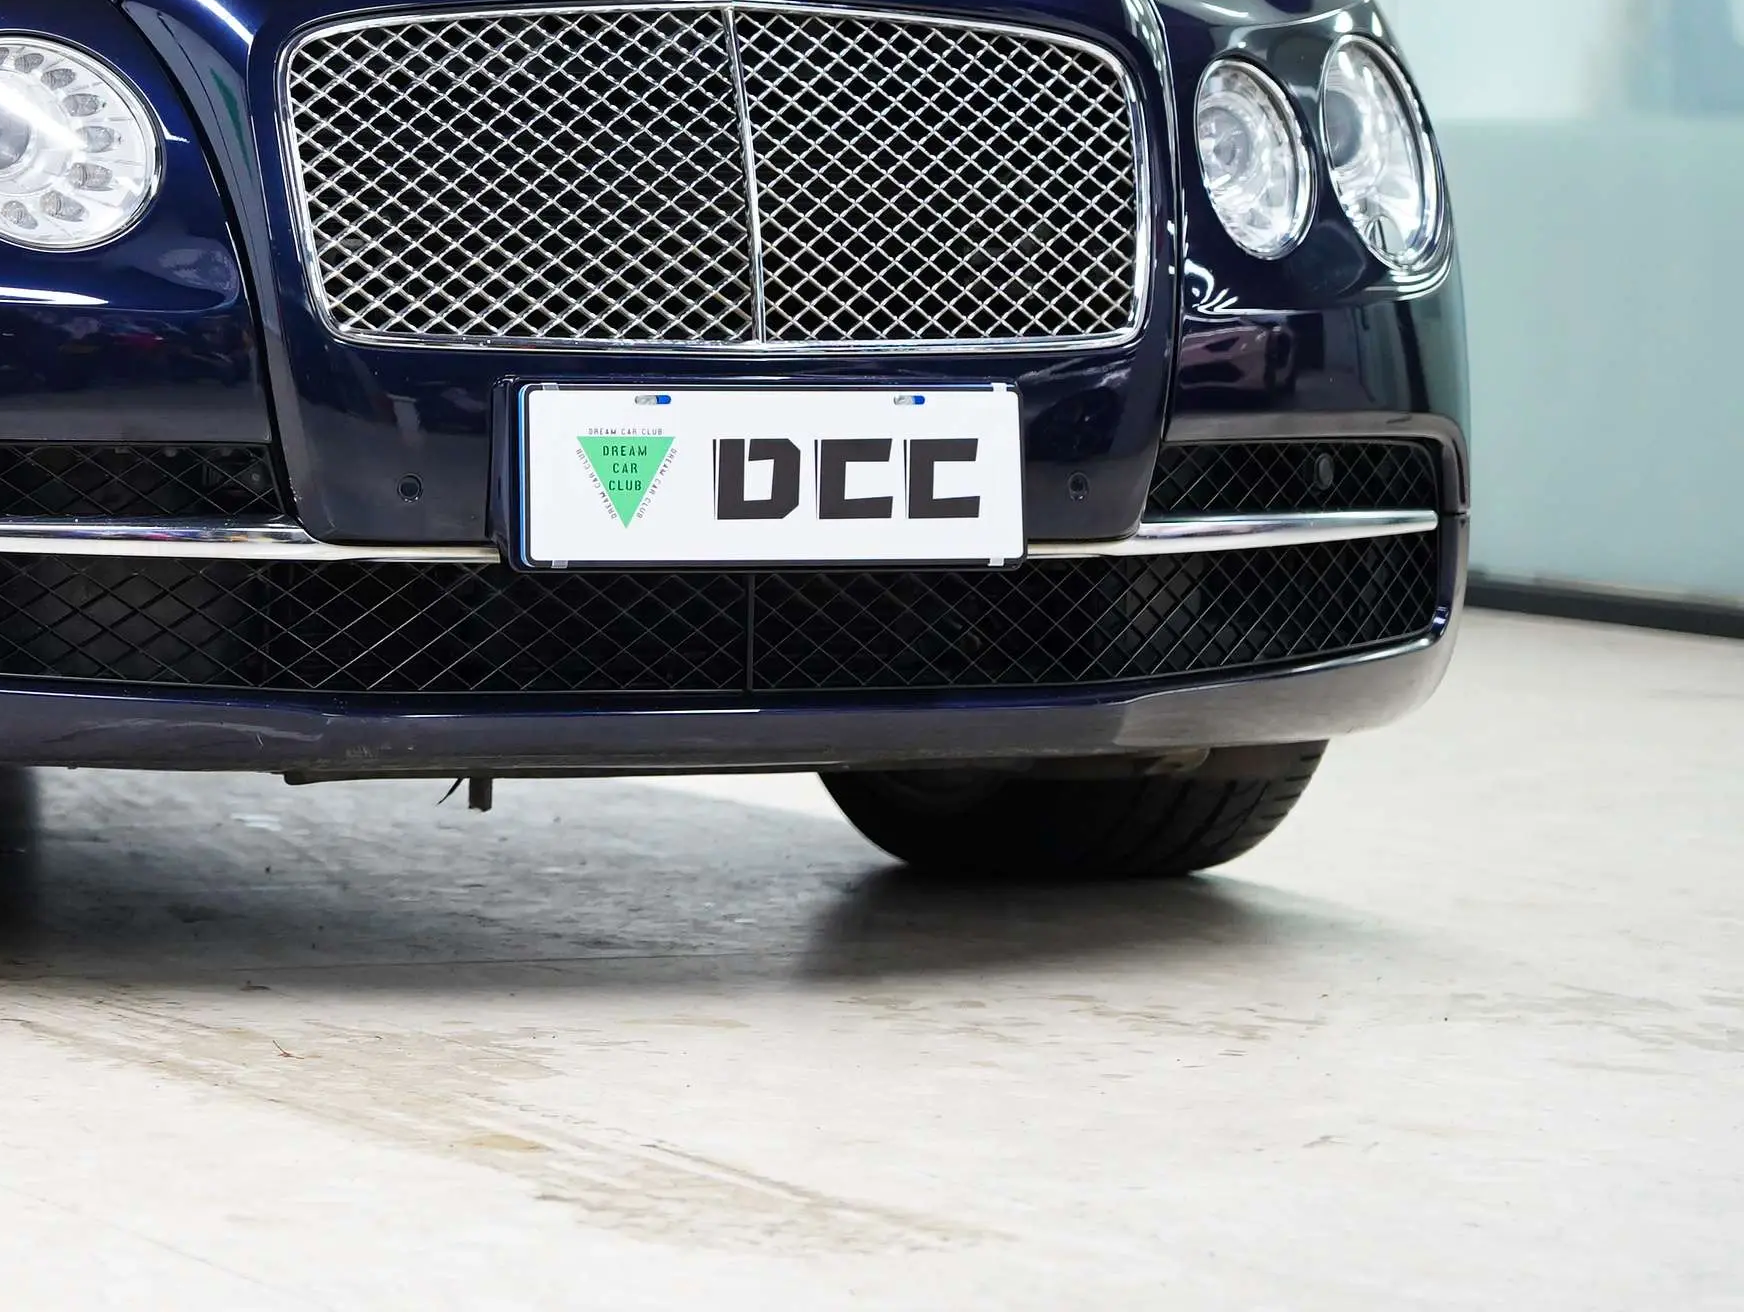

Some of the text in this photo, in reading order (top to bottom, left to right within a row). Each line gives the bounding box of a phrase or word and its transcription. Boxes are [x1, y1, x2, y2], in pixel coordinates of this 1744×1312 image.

[602, 445, 647, 456] DREAM
[612, 463, 638, 473] CAR
[712, 438, 981, 520] DCC
[608, 480, 642, 491] CLUB
